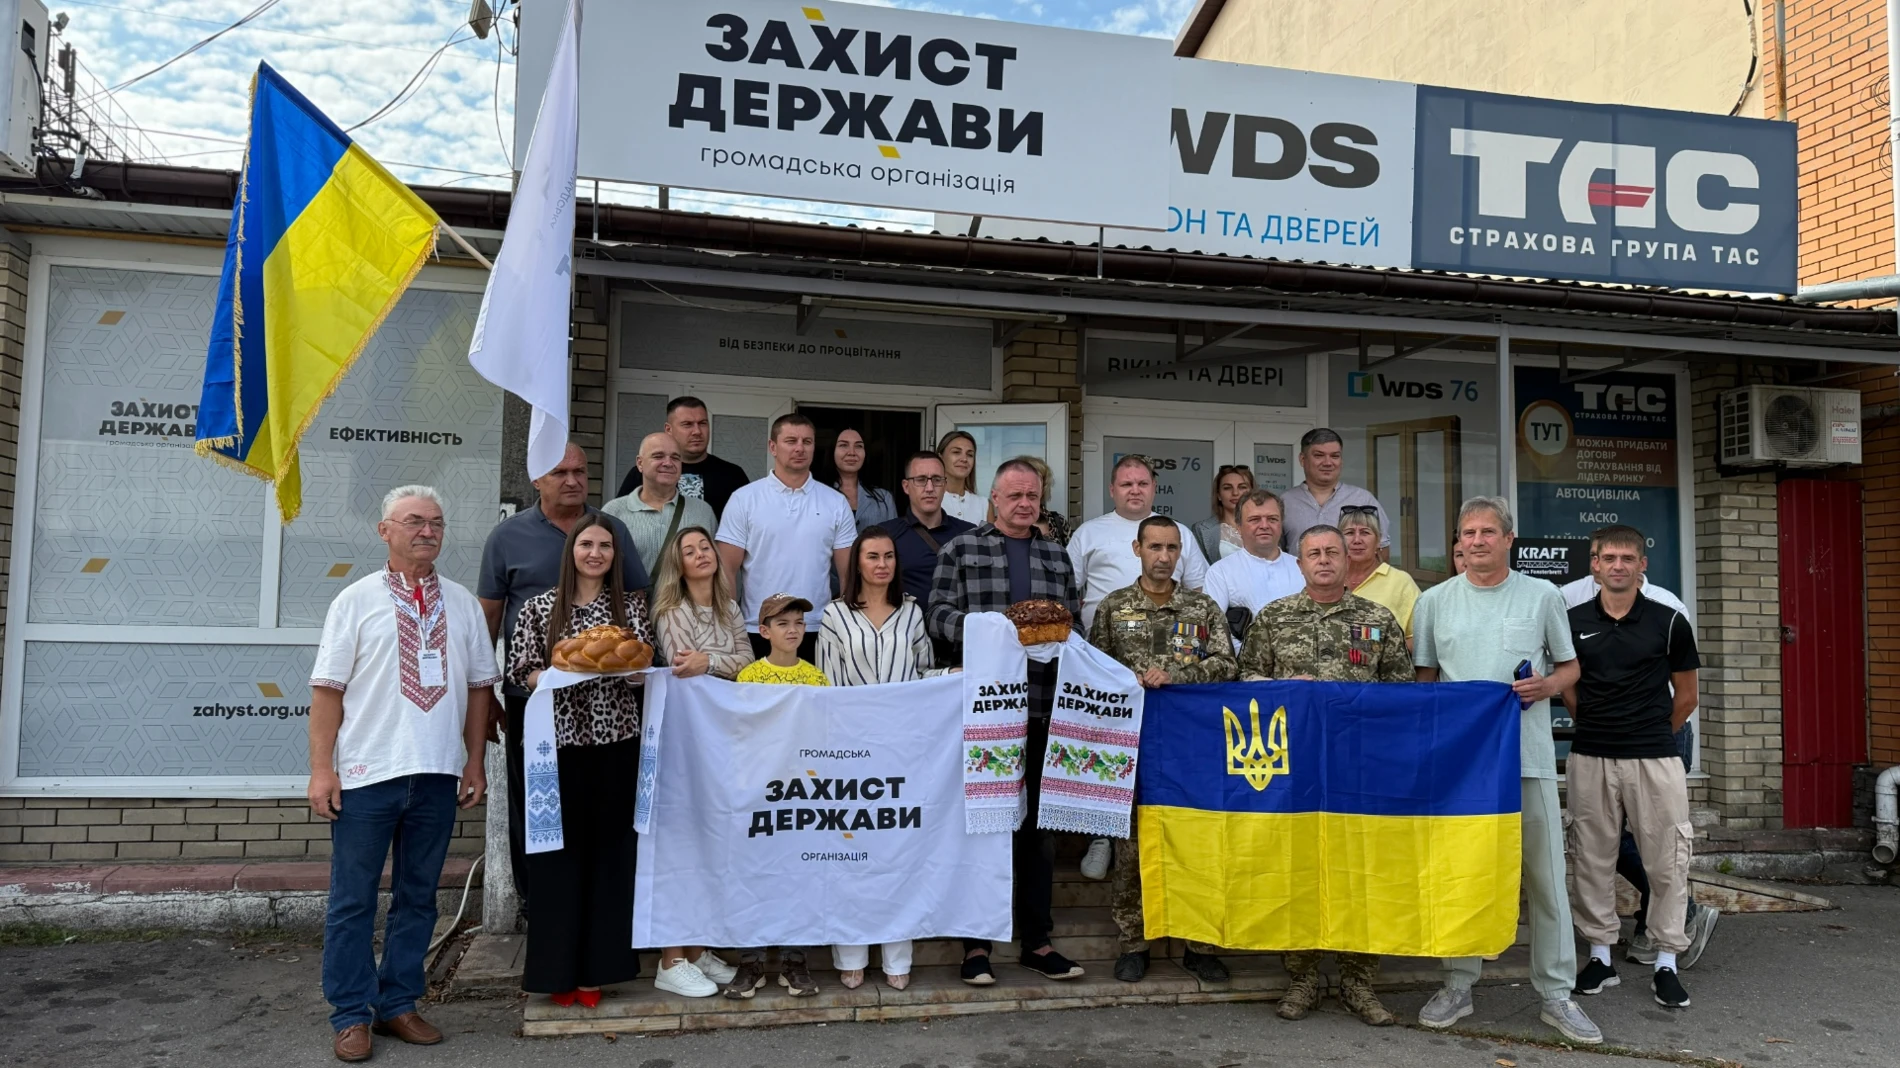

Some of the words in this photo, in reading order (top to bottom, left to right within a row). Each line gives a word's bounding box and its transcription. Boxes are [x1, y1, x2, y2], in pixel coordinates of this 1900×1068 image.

[705, 13, 1018, 91] ЗАХИСТ
[668, 73, 1044, 157] ДЕРЖАВИ
[700, 147, 862, 179] громадська
[870, 166, 1016, 195] організація
[1216, 211, 1253, 239] ТА
[1260, 214, 1380, 248] ДВЕРЕЙ
[1449, 226, 1596, 256] СТРАХОВА
[1611, 239, 1697, 262] ГРУПА
[1712, 245, 1760, 266] ТАС
[743, 339, 795, 353] БЕЗПЕКИ
[798, 343, 816, 354] ДО
[1217, 365, 1283, 388] ДВЕРІ
[1377, 373, 1444, 400] WDS
[1450, 379, 1479, 402] 76
[1574, 412, 1618, 420] СТРАХОВА
[1621, 414, 1648, 422] ГРУПА
[1652, 415, 1667, 423] ТАС
[329, 426, 463, 446] ЕФЕКТИВНІСТЬ
[1530, 422, 1563, 441] ТУТ
[1576, 439, 1614, 448] МОЖНА
[1616, 440, 1668, 451] ПРИДБАТИ
[1181, 456, 1201, 472] 76
[1576, 450, 1617, 460] ДОГОВІР
[1576, 461, 1644, 472] СТРАХУВАННЯ
[1646, 464, 1662, 474] ВІД
[1576, 473, 1611, 483] ЛІДЕРА
[1555, 487, 1641, 502] АВТОЦИВІЛКА
[1579, 512, 1619, 523] КАСКО
[1518, 547, 1569, 560] KRAFT
[1062, 682, 1129, 705] ЗАХИСТ
[1057, 696, 1133, 719] ДЕРЖАВИ
[799, 749, 871, 760] ГРОМАДСЬКА
[765, 776, 906, 803] ЗАХИСТ
[748, 806, 922, 838] ДЕРЖАВИ
[801, 852, 868, 862] ОРГАНІЗАЦІЯ
